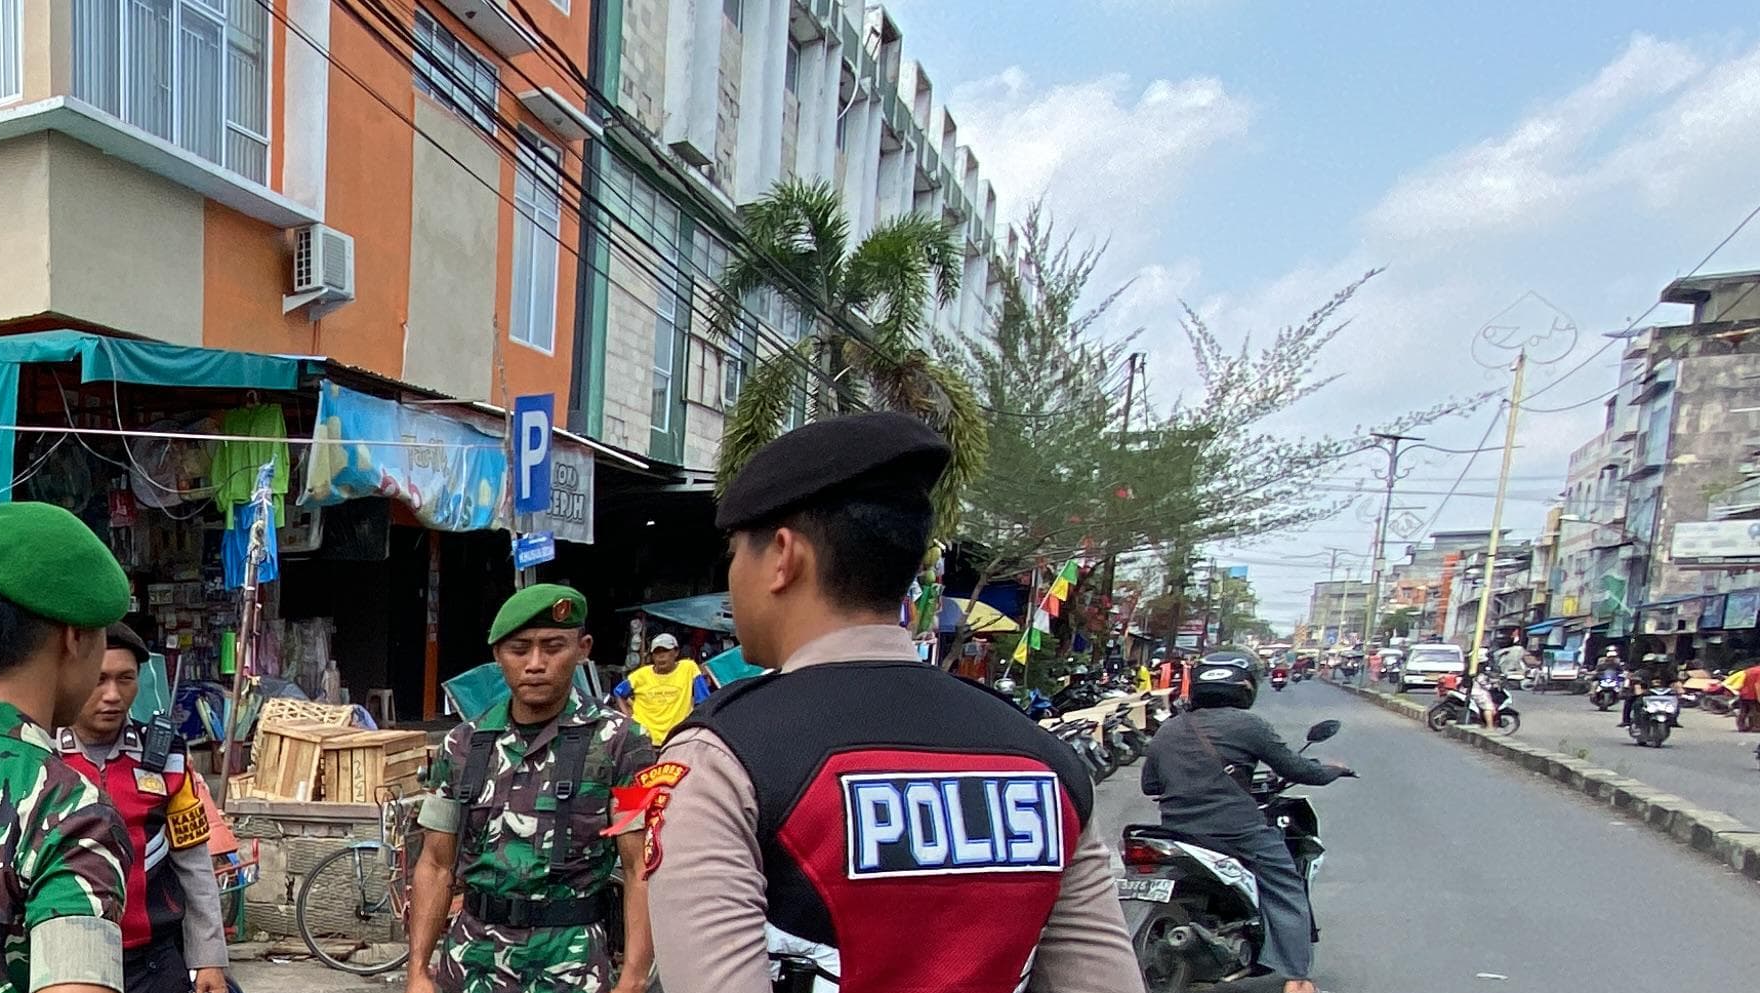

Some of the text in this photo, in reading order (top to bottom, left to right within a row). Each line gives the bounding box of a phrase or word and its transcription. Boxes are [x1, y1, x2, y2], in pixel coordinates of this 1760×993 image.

[521, 411, 548, 499] P
[640, 763, 684, 786] POLRES
[853, 778, 1058, 871] POLISI
